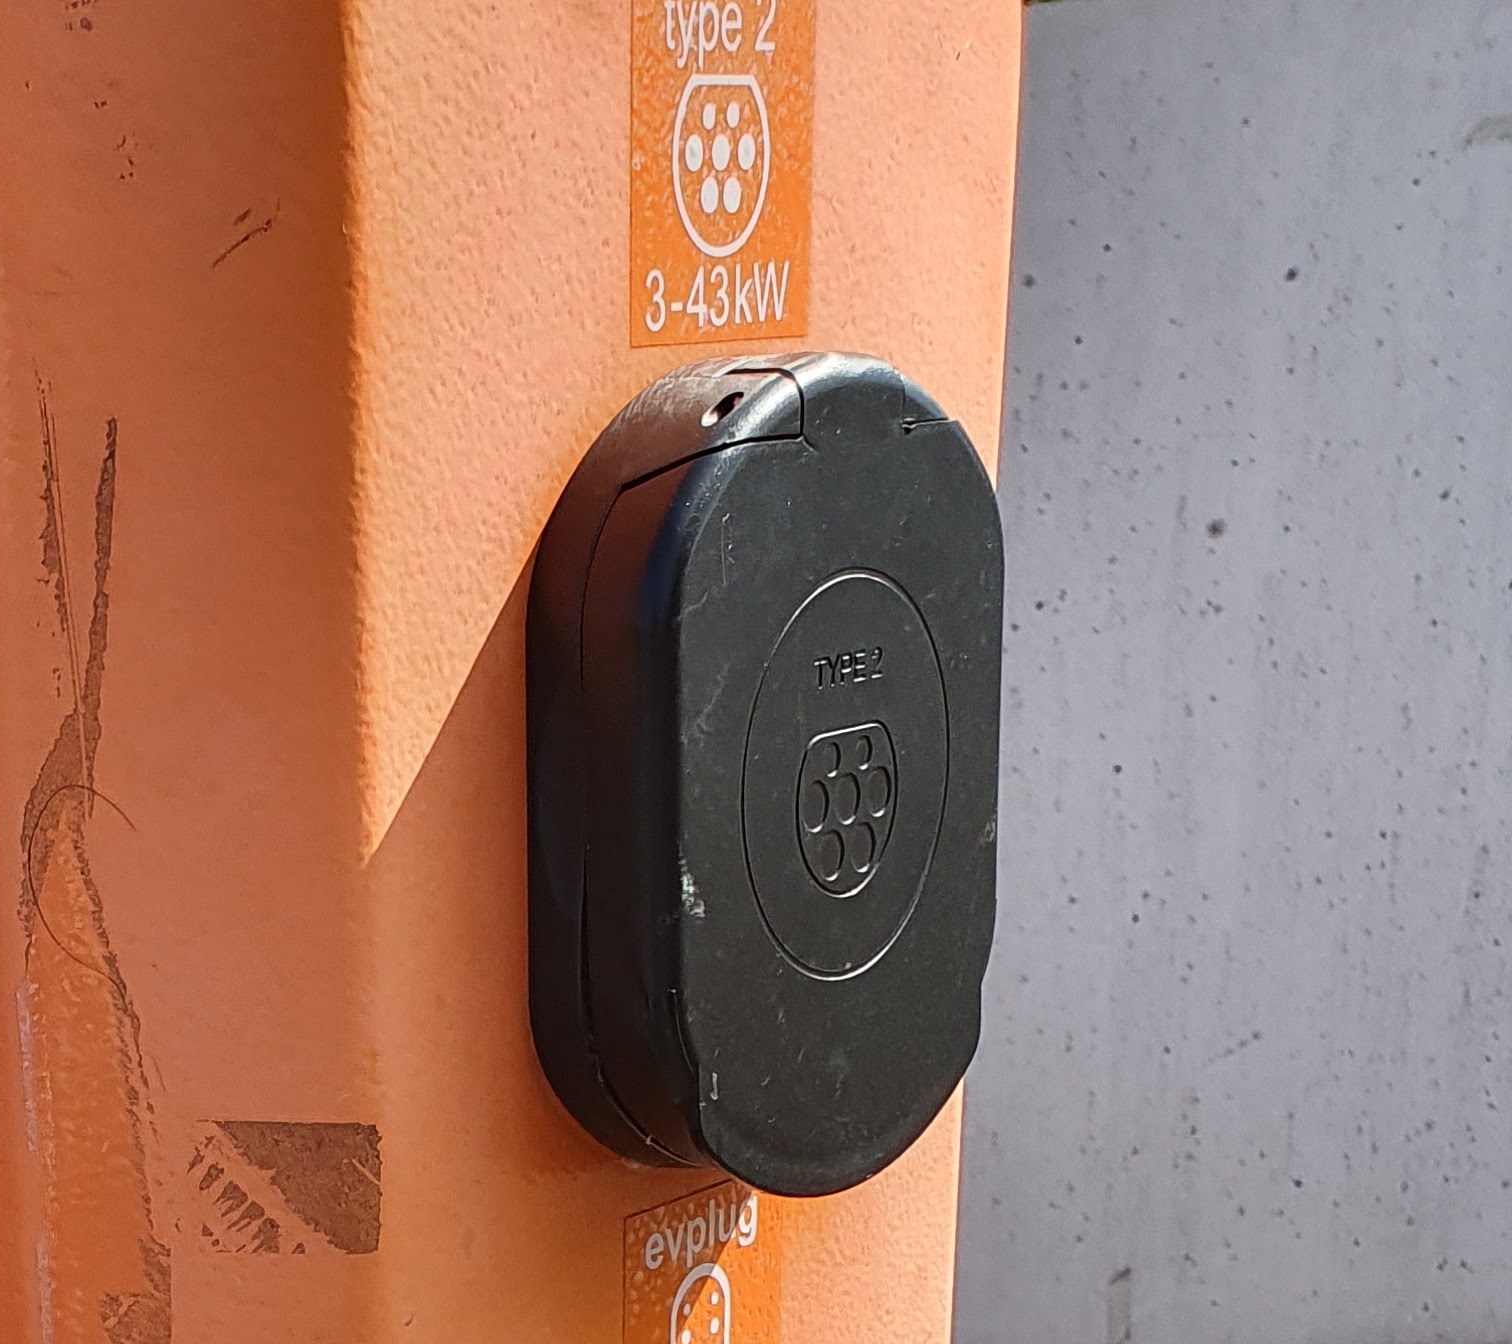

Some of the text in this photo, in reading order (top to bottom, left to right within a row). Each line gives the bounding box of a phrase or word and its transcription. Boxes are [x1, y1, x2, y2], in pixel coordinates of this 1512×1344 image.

[664, 0, 776, 70] type 2
[813, 649, 867, 690] TYPE
[644, 1192, 759, 1270] evplug
